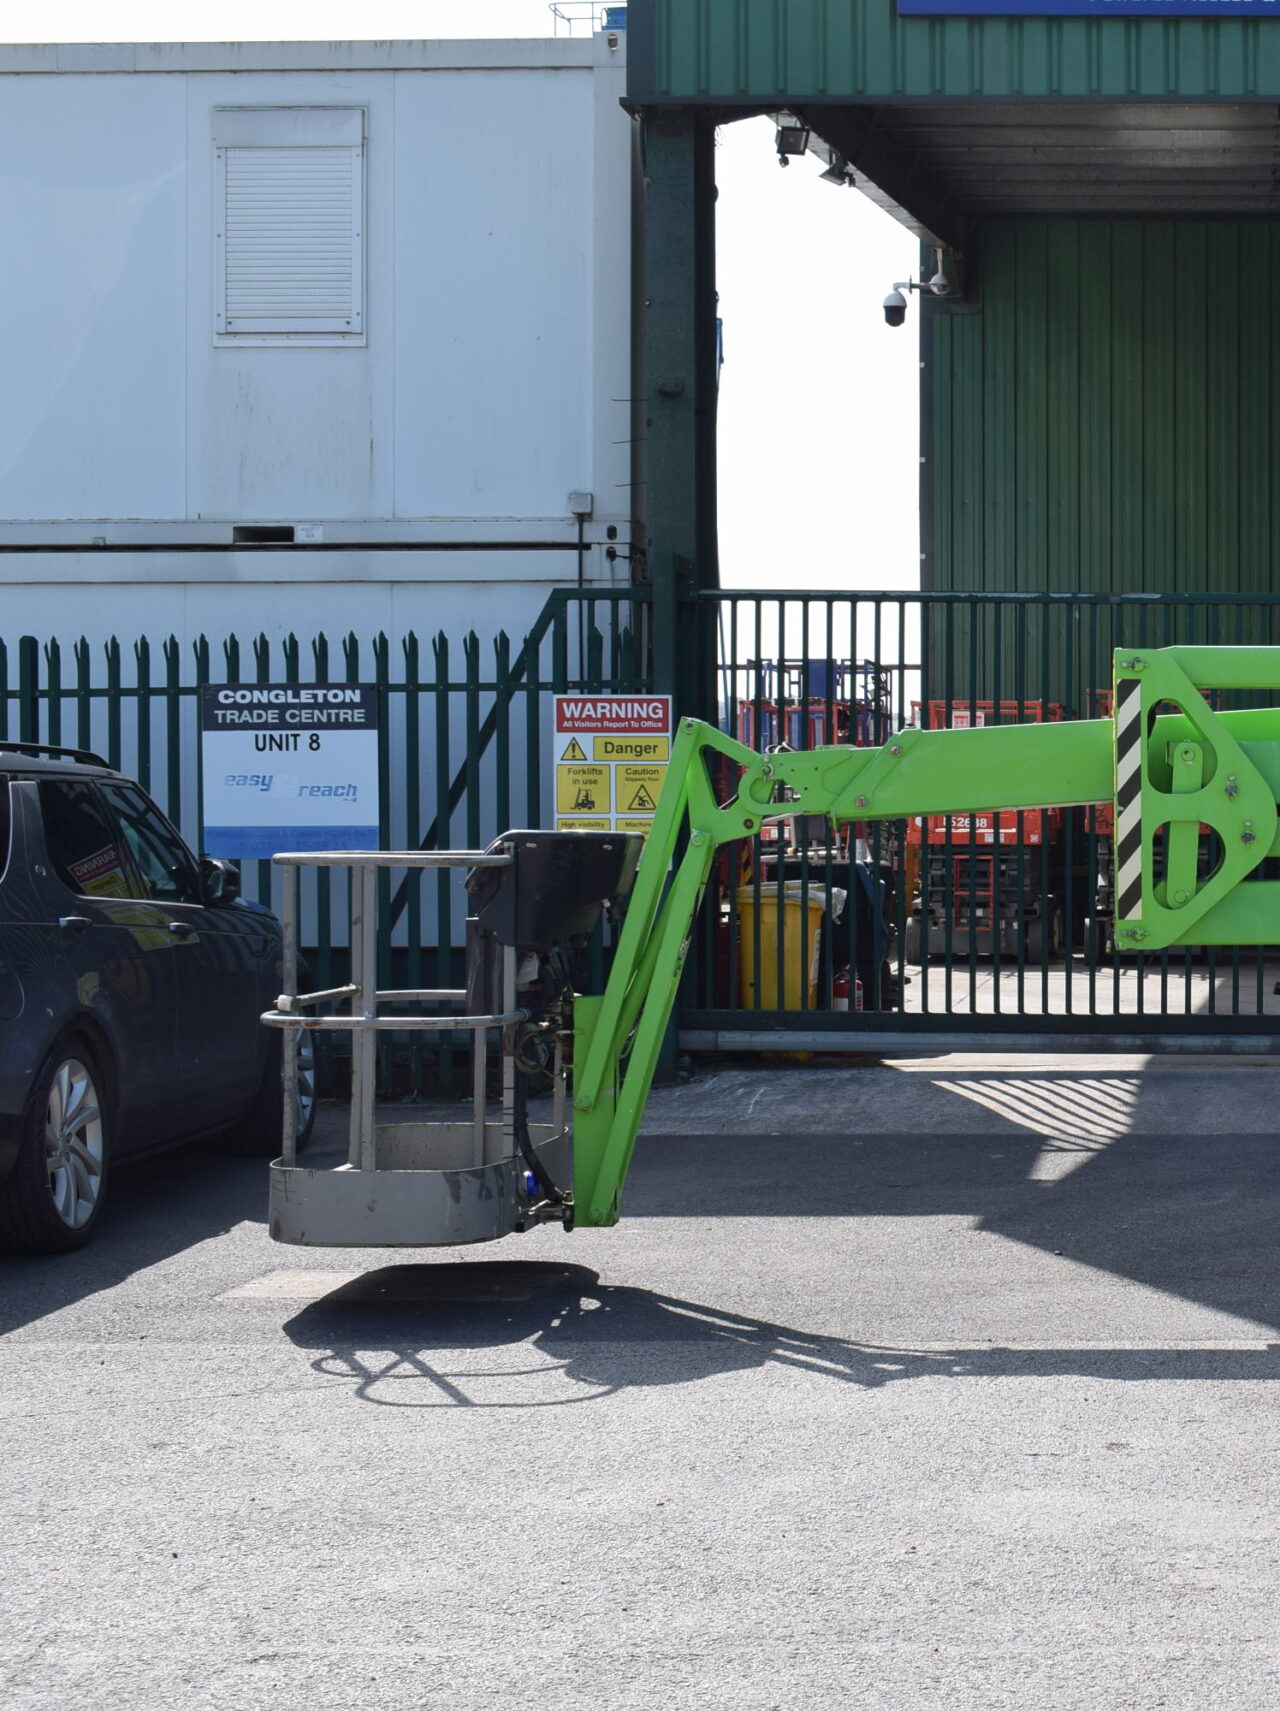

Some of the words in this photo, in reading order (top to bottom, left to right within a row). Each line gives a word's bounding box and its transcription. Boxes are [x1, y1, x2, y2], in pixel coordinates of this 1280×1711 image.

[218, 689, 361, 704] CONGLETON
[214, 709, 280, 723] TRADE
[285, 708, 366, 723] CENTRE
[562, 702, 663, 718] WARNING
[574, 720, 601, 728] Visitors
[603, 721, 628, 729] Report
[630, 720, 639, 728] To
[640, 720, 662, 728] Office
[254, 733, 301, 751] UNIT
[308, 733, 321, 751] 8
[604, 741, 658, 757] Danger
[567, 767, 603, 776] Forklifts
[625, 767, 659, 776] Caution
[224, 774, 273, 792] easy
[297, 783, 358, 797] reach
[561, 821, 576, 829] High
[578, 821, 605, 829] visibility
